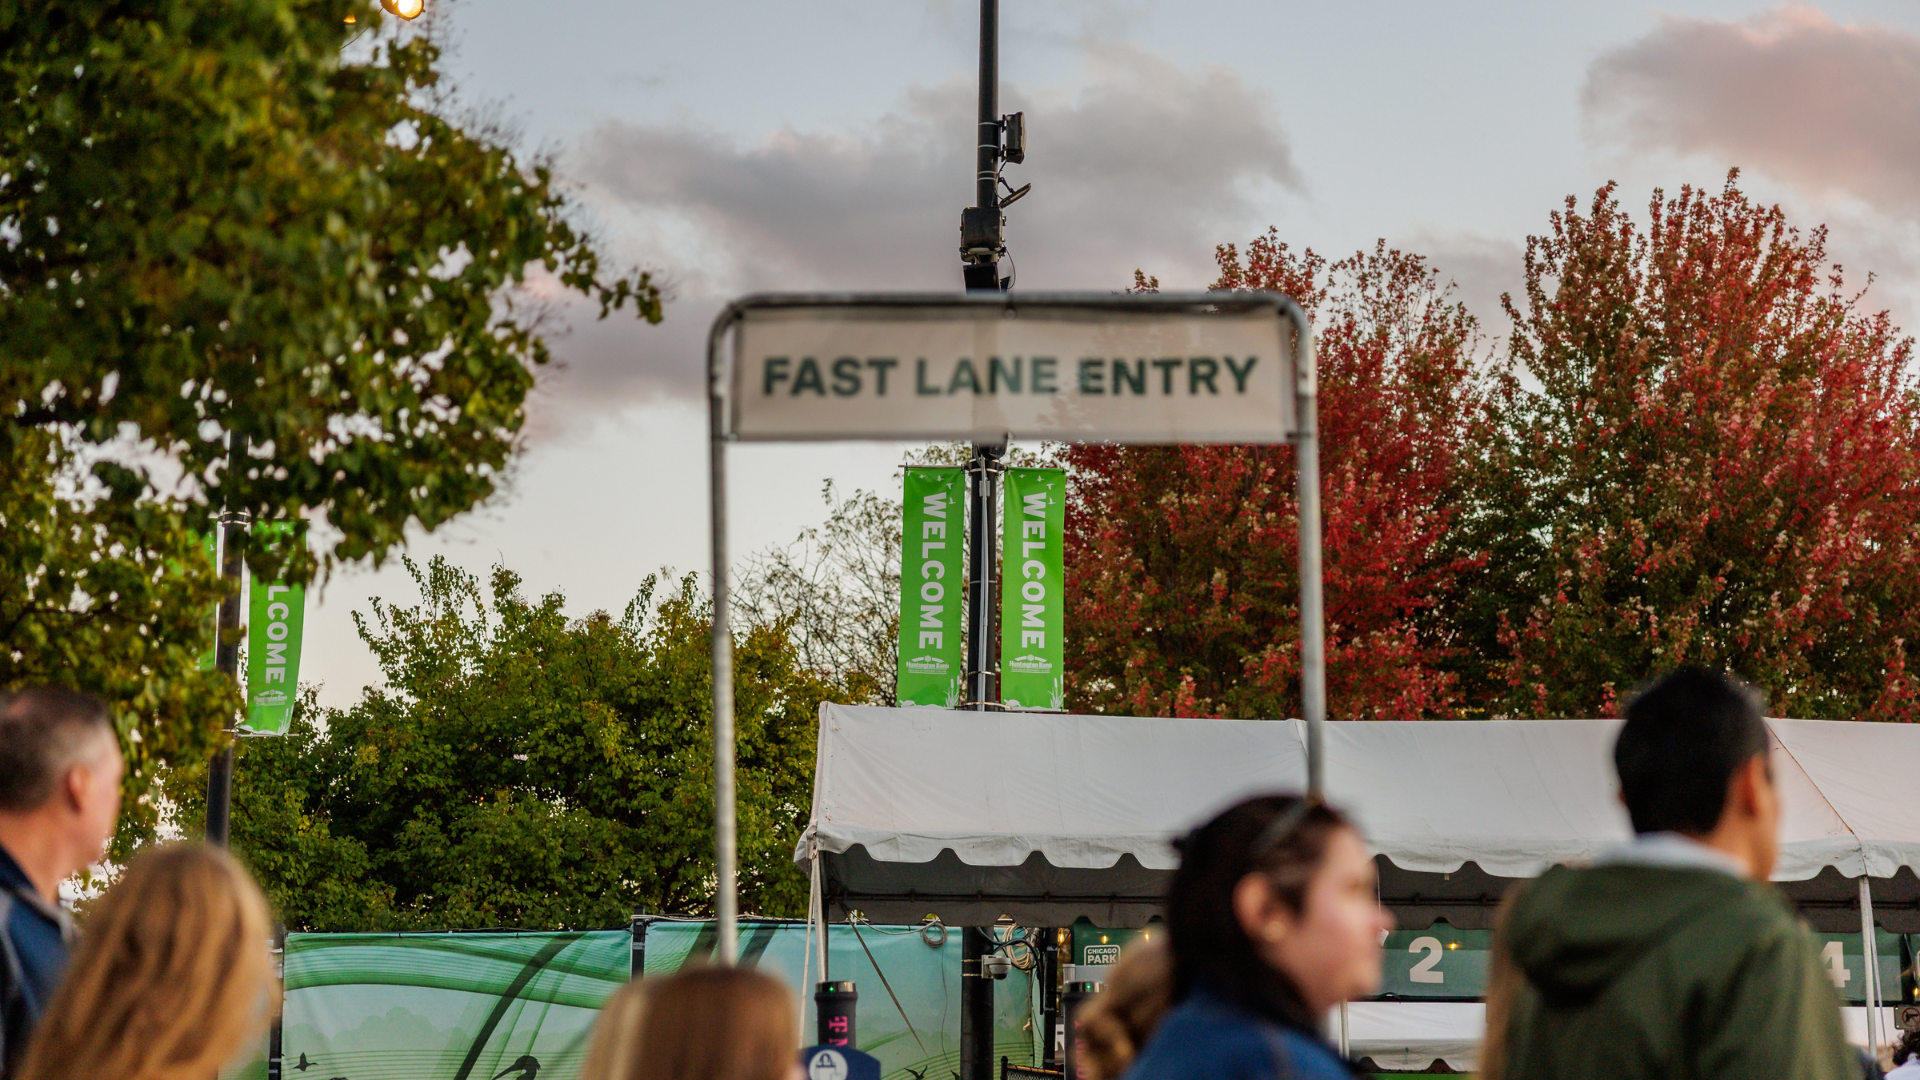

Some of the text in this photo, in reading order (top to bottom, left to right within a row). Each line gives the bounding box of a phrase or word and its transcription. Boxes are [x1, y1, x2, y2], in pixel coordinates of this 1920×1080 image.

[762, 356, 1259, 397] FAST LANE ENTRY
[920, 492, 947, 650] WELCOME
[1022, 492, 1048, 649] WELCOME
[266, 543, 290, 683] LCOME
[1087, 955, 1117, 964] PARK
[1409, 936, 1443, 983] 2
[1820, 941, 1850, 988] 4
